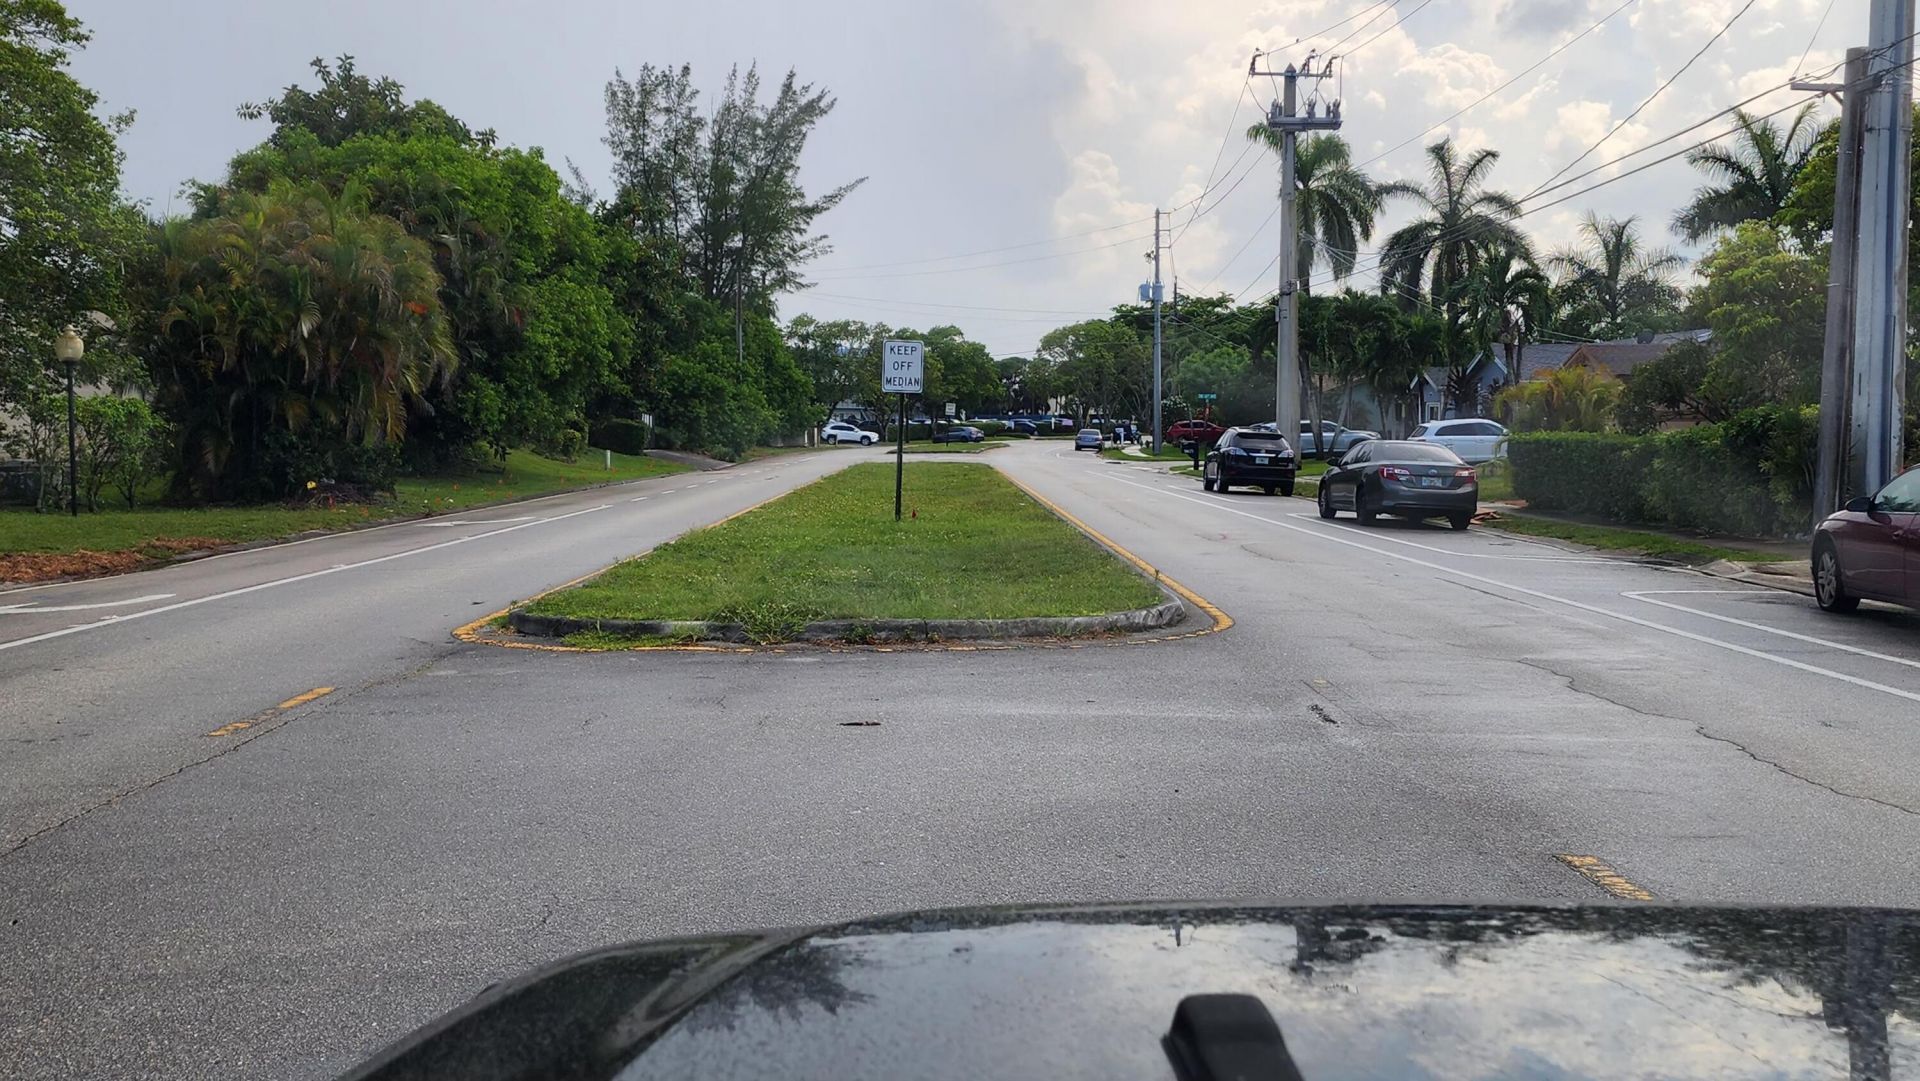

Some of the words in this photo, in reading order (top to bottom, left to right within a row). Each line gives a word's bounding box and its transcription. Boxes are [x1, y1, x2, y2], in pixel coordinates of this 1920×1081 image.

[890, 345, 917, 356] KEEP
[893, 361, 913, 371] OFF
[886, 377, 920, 387] MEDIAN
